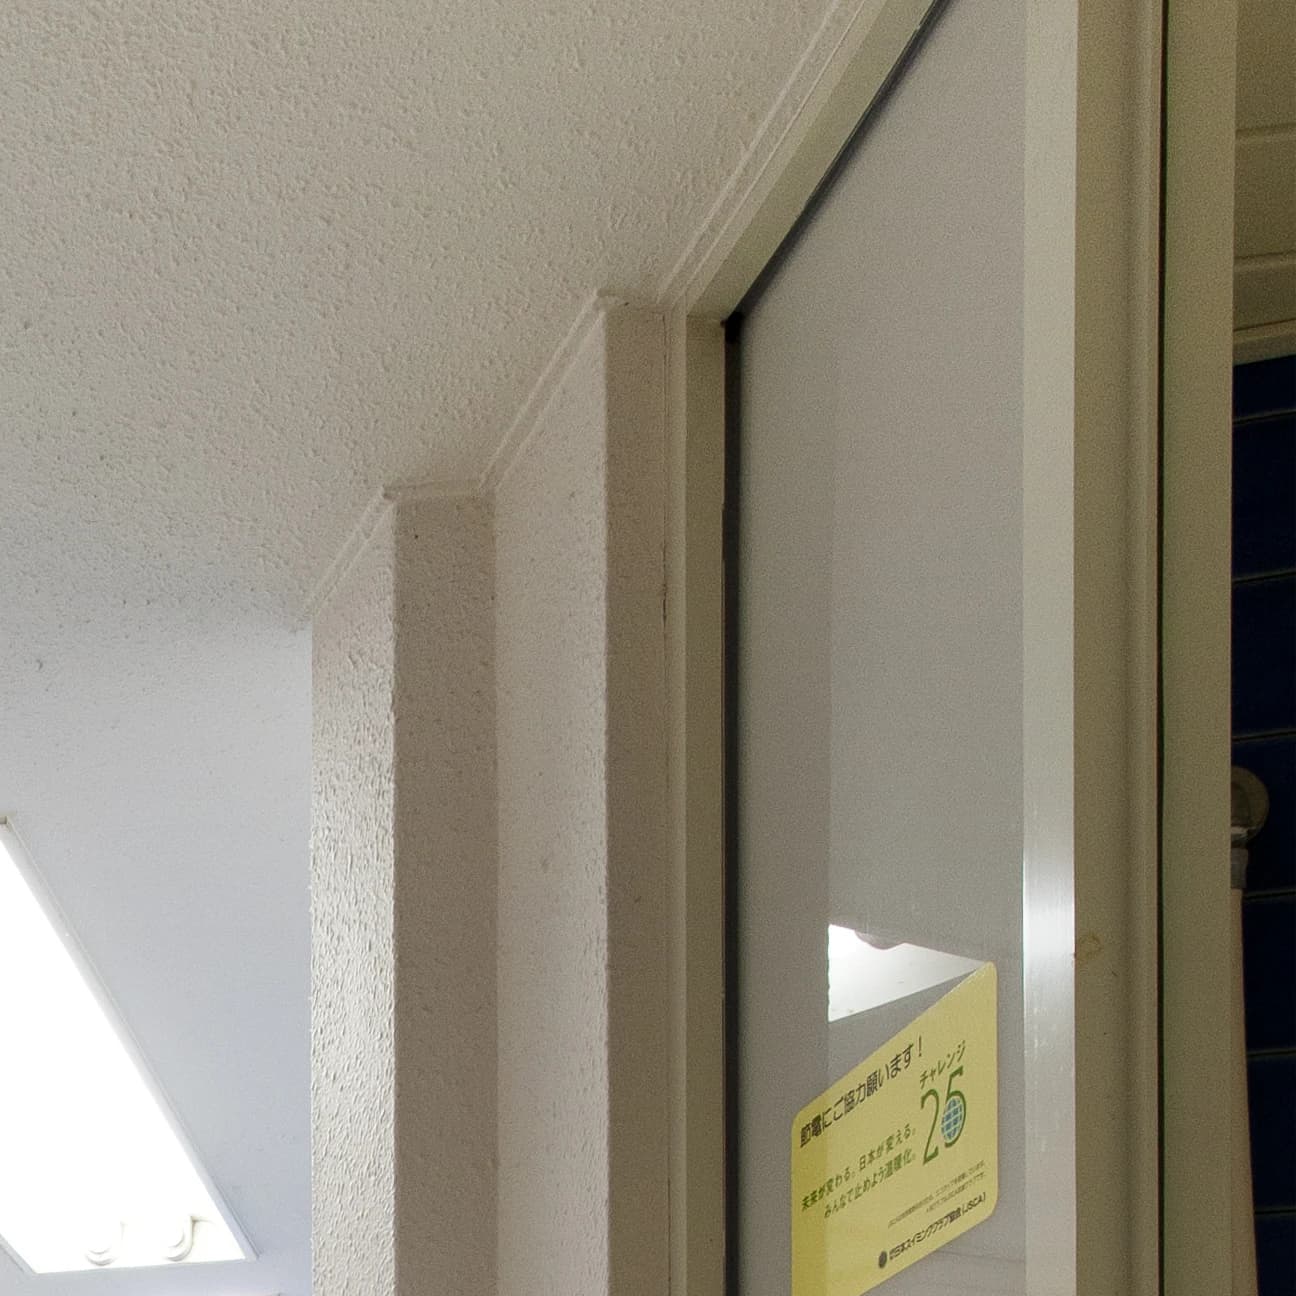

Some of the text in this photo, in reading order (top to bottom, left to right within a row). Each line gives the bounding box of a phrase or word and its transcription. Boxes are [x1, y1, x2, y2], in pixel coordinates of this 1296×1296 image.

[919, 1039, 966, 1089] チャレンジ
[920, 1066, 967, 1165] 25
